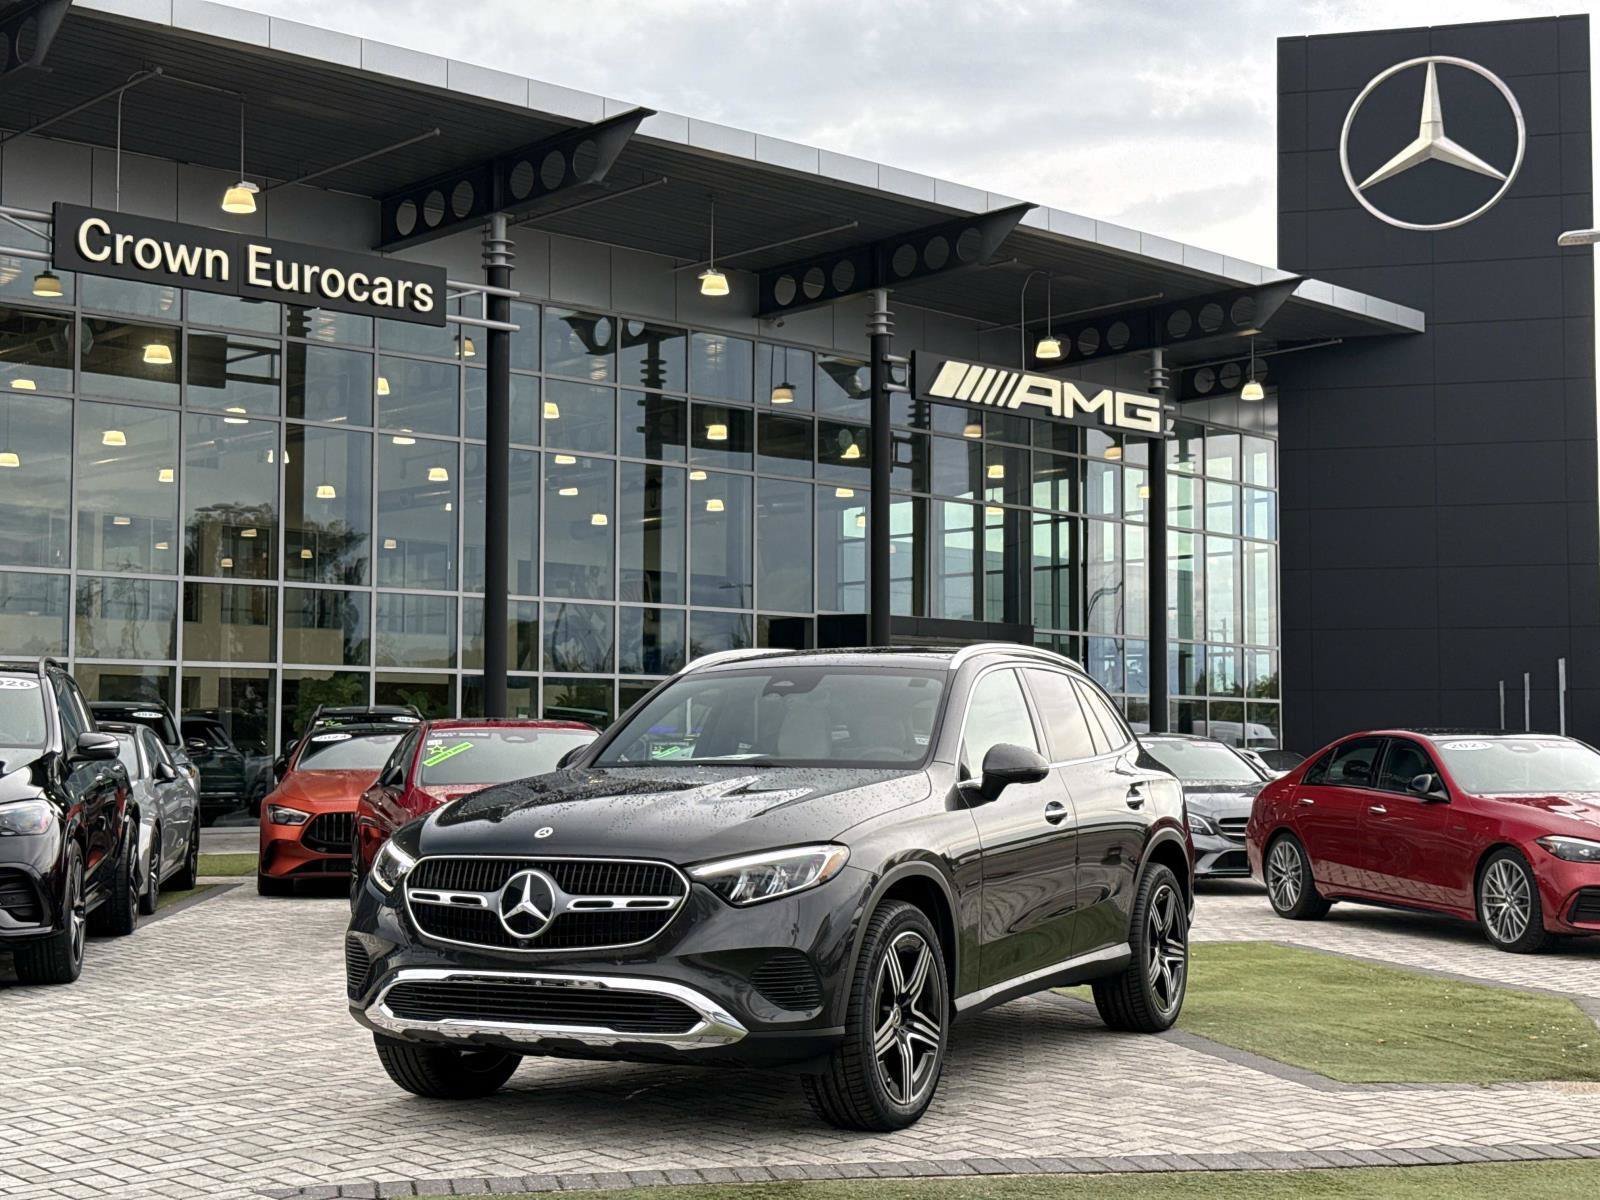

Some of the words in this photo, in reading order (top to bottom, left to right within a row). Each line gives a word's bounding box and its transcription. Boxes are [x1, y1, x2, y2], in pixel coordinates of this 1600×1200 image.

[76, 217, 230, 281] Crown
[245, 243, 435, 312] Eurocars
[1007, 374, 1161, 433] AMG
